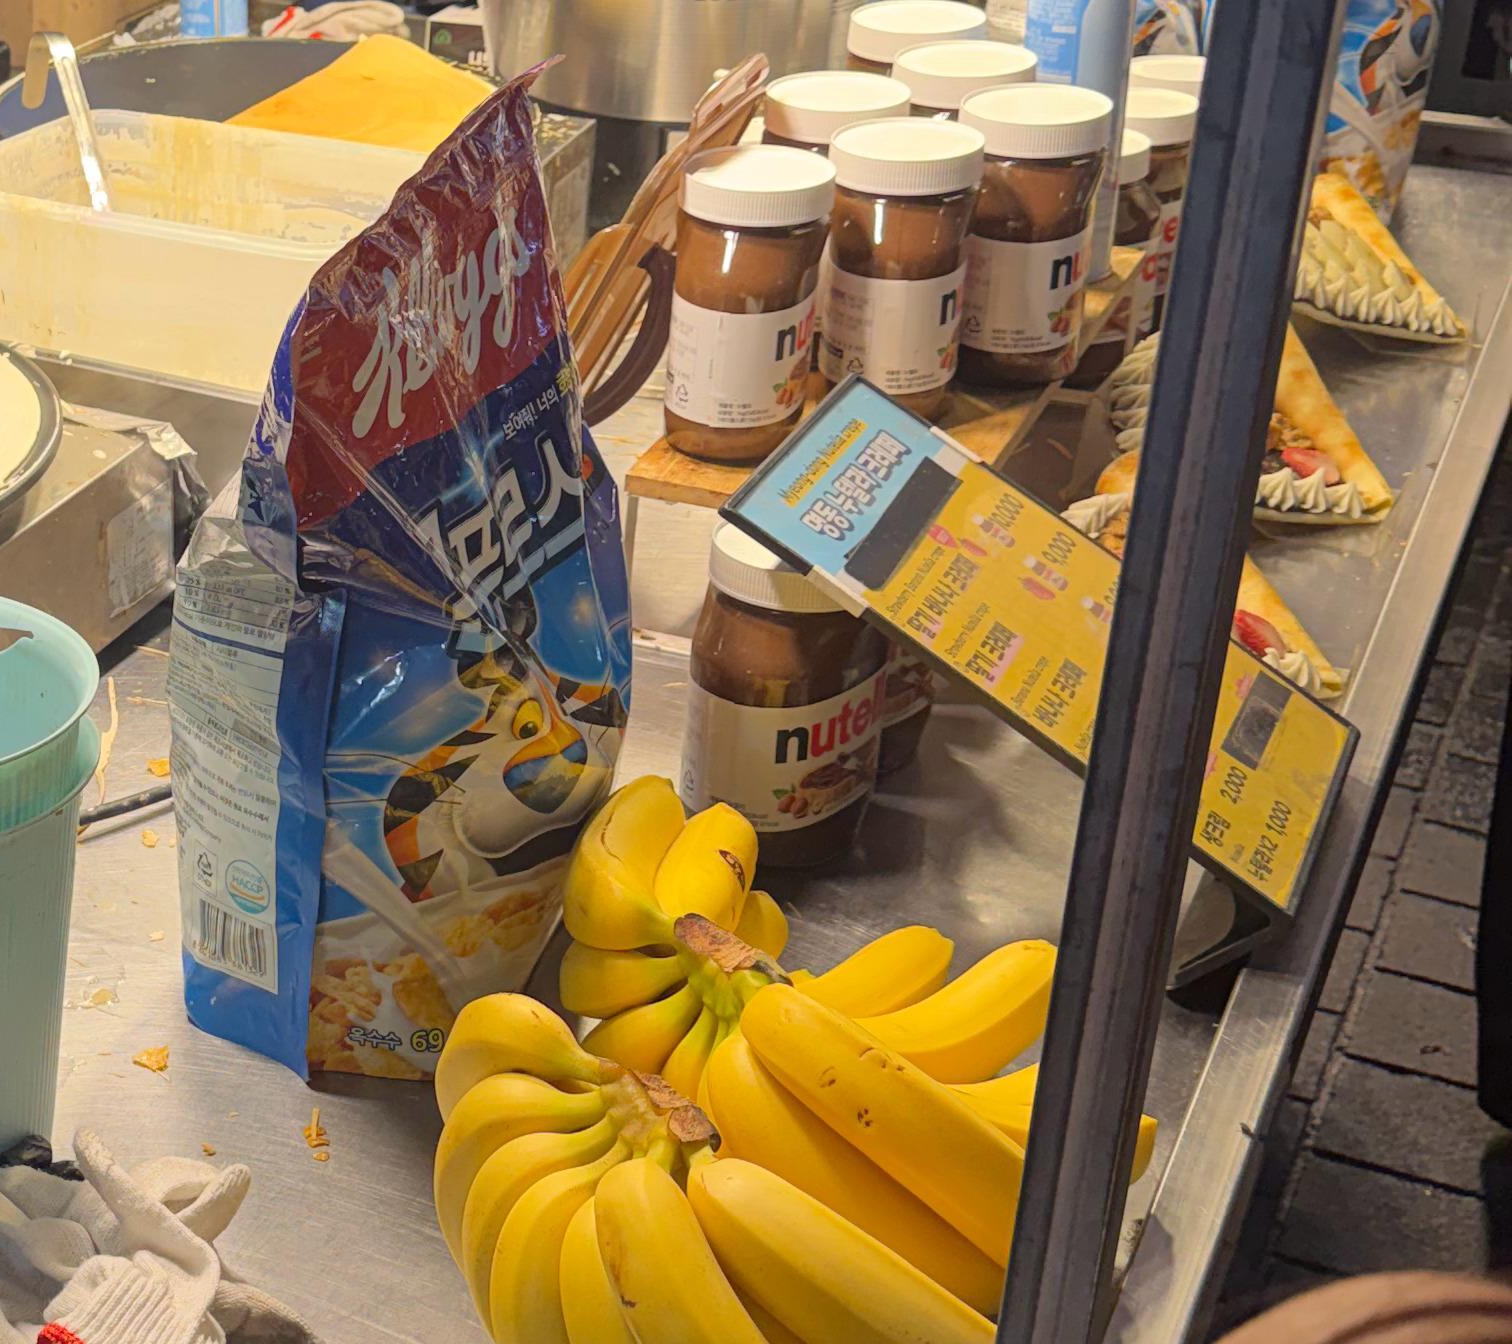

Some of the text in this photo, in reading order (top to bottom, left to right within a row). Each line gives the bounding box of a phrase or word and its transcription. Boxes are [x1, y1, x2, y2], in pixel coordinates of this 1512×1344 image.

[503, 402, 538, 440] 보여줘!
[536, 384, 559, 411] 너의
[855, 429, 912, 482] 크레페
[823, 463, 883, 515] 누텔라
[800, 499, 855, 541] 명동
[990, 492, 1025, 531] 10,000
[1041, 531, 1077, 567] 9,000
[922, 579, 960, 617] 바나나
[906, 608, 941, 639] 딸기
[965, 621, 1019, 683] 딸기 크레페
[1032, 688, 1070, 728] 바나나
[1200, 766, 1248, 847] 생크림 2,000
[1265, 800, 1292, 837] 1,000
[232, 875, 265, 894] HACCP
[348, 1027, 403, 1051] 옥수수
